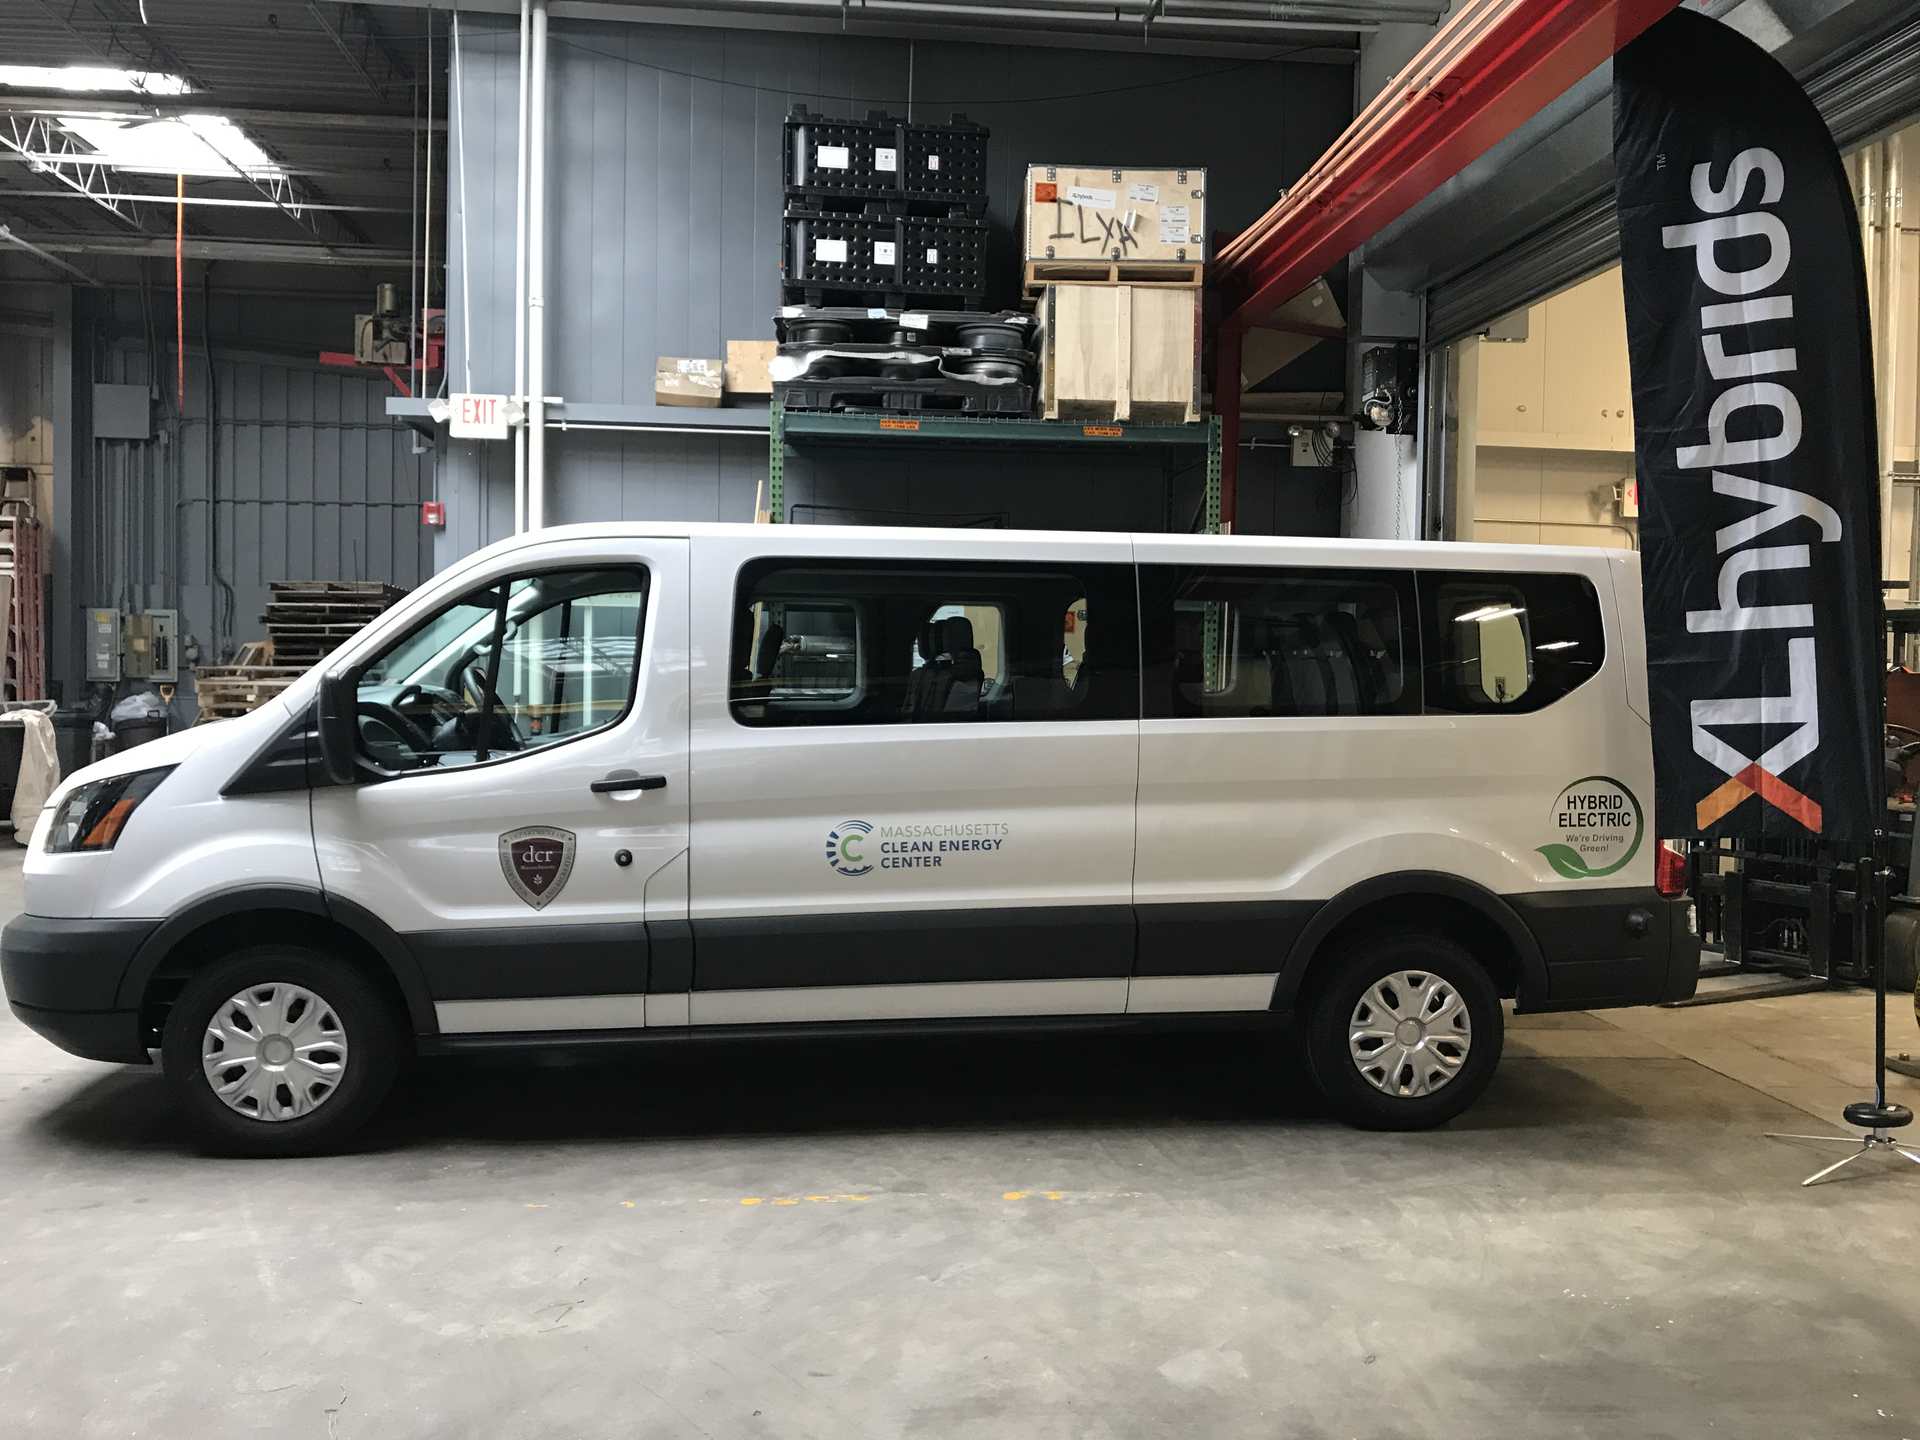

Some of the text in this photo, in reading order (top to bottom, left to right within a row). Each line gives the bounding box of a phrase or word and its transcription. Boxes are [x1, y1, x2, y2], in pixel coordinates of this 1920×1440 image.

[462, 398, 497, 425] EXIT
[1662, 147, 1842, 835] XLhybrids
[1567, 795, 1623, 810] HYBRID
[1558, 812, 1631, 828] ELECTRIC
[509, 829, 555, 840] DEPARTMENT
[880, 823, 1009, 838] MASSACHUSETTS
[1565, 834, 1624, 843] We're Driving
[522, 845, 553, 863] dcr
[880, 839, 1003, 854] CLEAN ENERGY
[880, 856, 942, 869] CENTER
